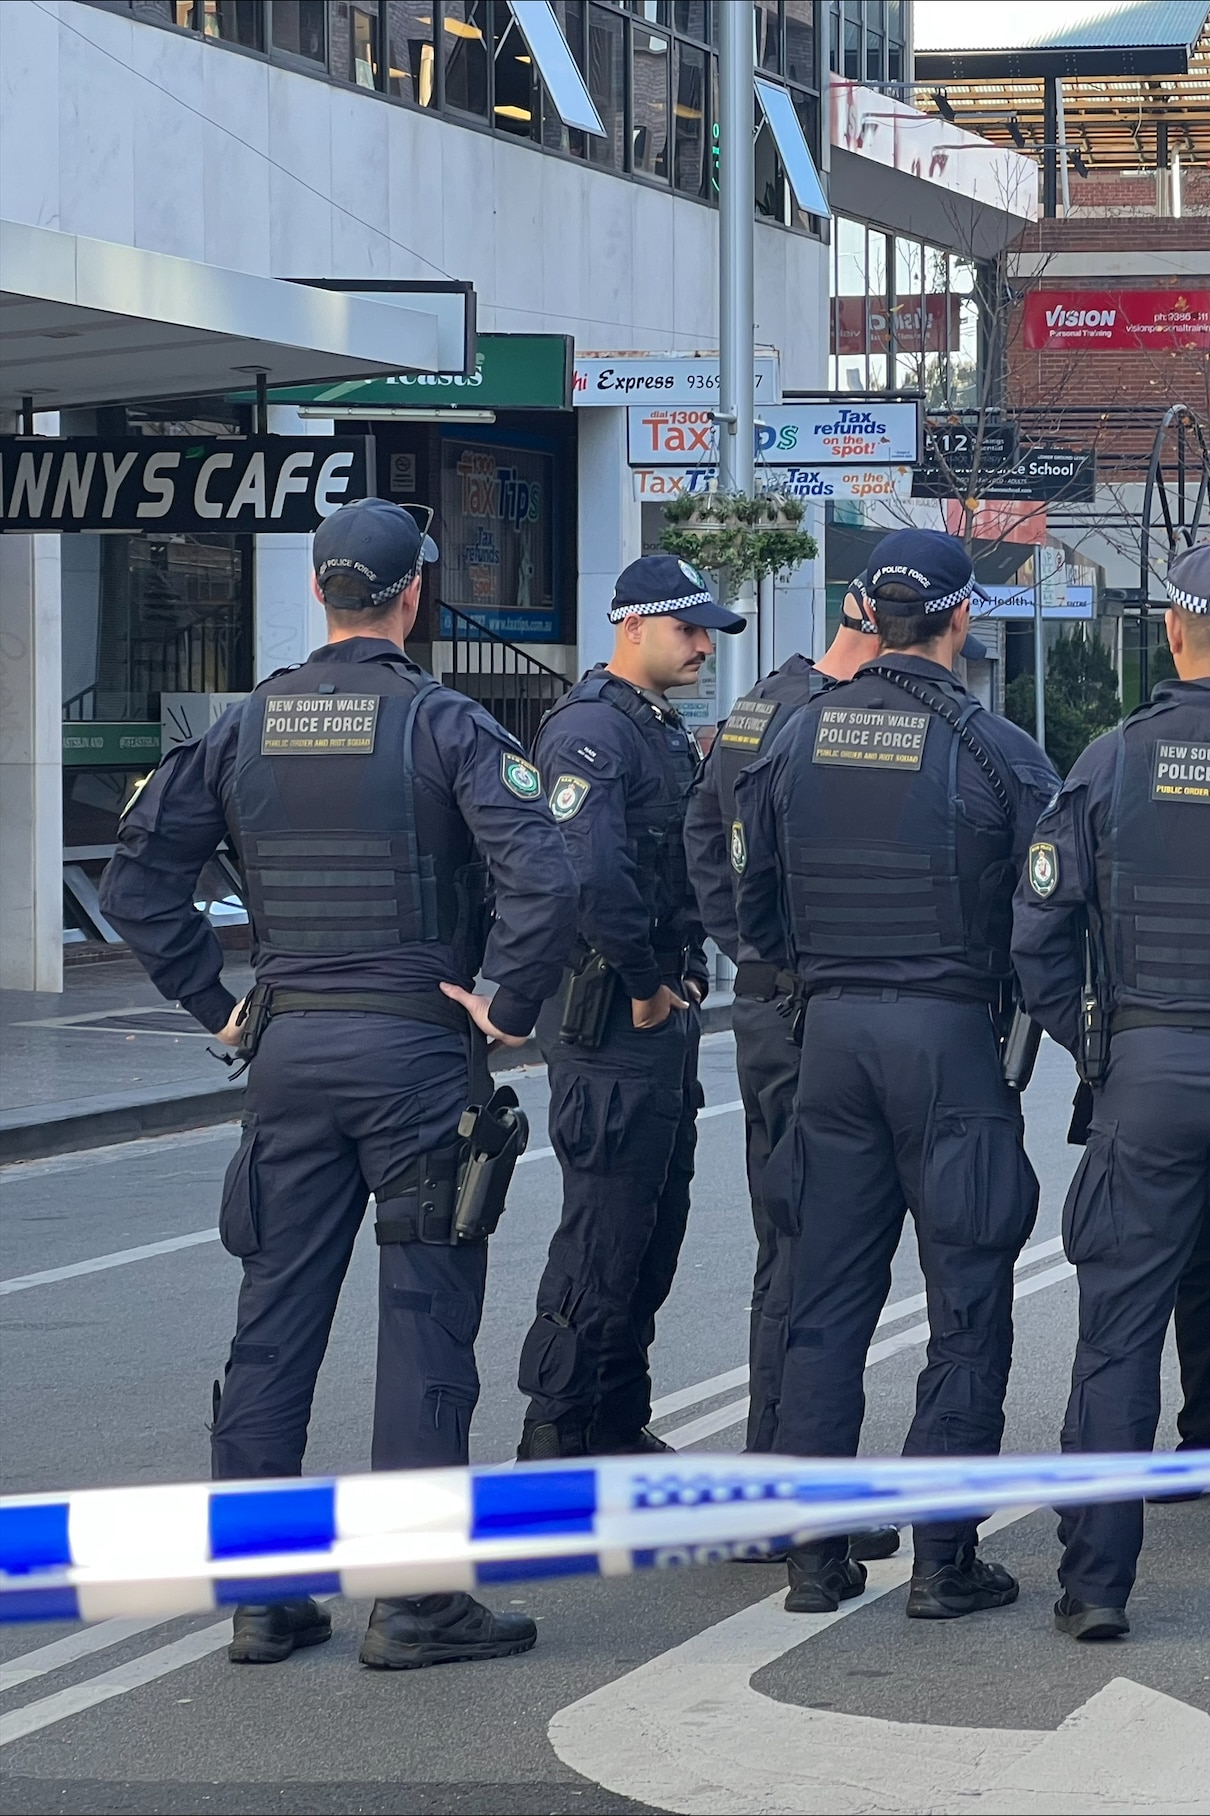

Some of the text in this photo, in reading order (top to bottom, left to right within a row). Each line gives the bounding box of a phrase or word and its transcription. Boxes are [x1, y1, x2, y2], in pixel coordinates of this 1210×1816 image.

[1046, 305, 1116, 327] VISION
[1083, 330, 1112, 338] Training
[597, 369, 674, 393] Express
[669, 412, 709, 424] 1300
[839, 409, 872, 423] Tax
[814, 421, 887, 434] refunds
[823, 435, 863, 445] on the
[832, 442, 875, 458] spot!
[788, 469, 820, 483] Tax
[1029, 462, 1073, 476] School
[843, 472, 883, 483] on the
[0, 452, 354, 518] NNYS CAFE
[851, 480, 896, 497] spot!
[327, 559, 352, 567] POLICE
[354, 562, 377, 581] FORCE
[882, 566, 907, 574] POLICE
[908, 569, 931, 588] FORCE
[268, 699, 374, 712] NEW SOUTH WALES
[266, 717, 373, 732] POLICE FORCE
[823, 712, 925, 729] NEW SOUTH WALES
[819, 728, 922, 748] POLICE FORCE
[1160, 746, 1187, 759] NEW
[1156, 785, 1183, 795] PUBLIC
[1184, 787, 1209, 796] ORDER
